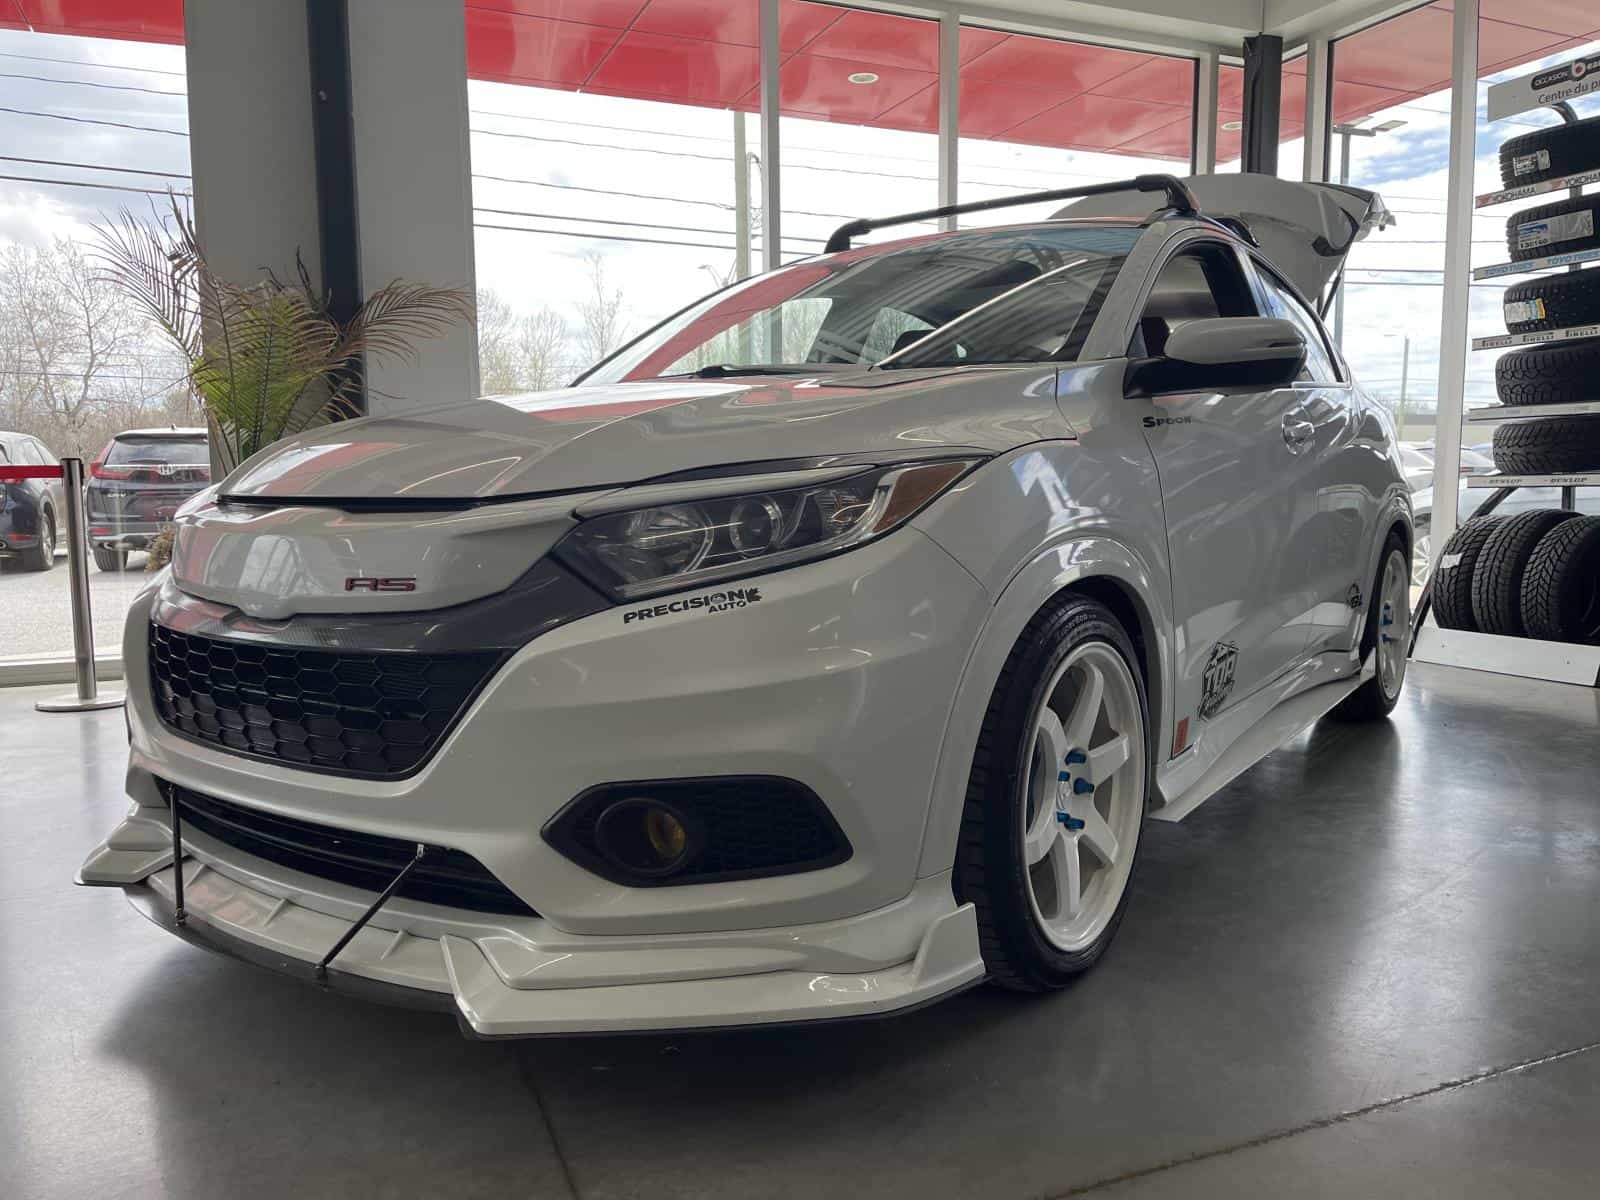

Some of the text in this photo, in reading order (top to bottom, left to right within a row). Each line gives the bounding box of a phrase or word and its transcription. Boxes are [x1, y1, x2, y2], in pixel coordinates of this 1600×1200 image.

[1538, 88, 1572, 104] Centre
[1574, 82, 1589, 93] du
[344, 577, 417, 592] RS
[623, 588, 746, 624] PRECISION
[708, 601, 746, 614] AUTO
